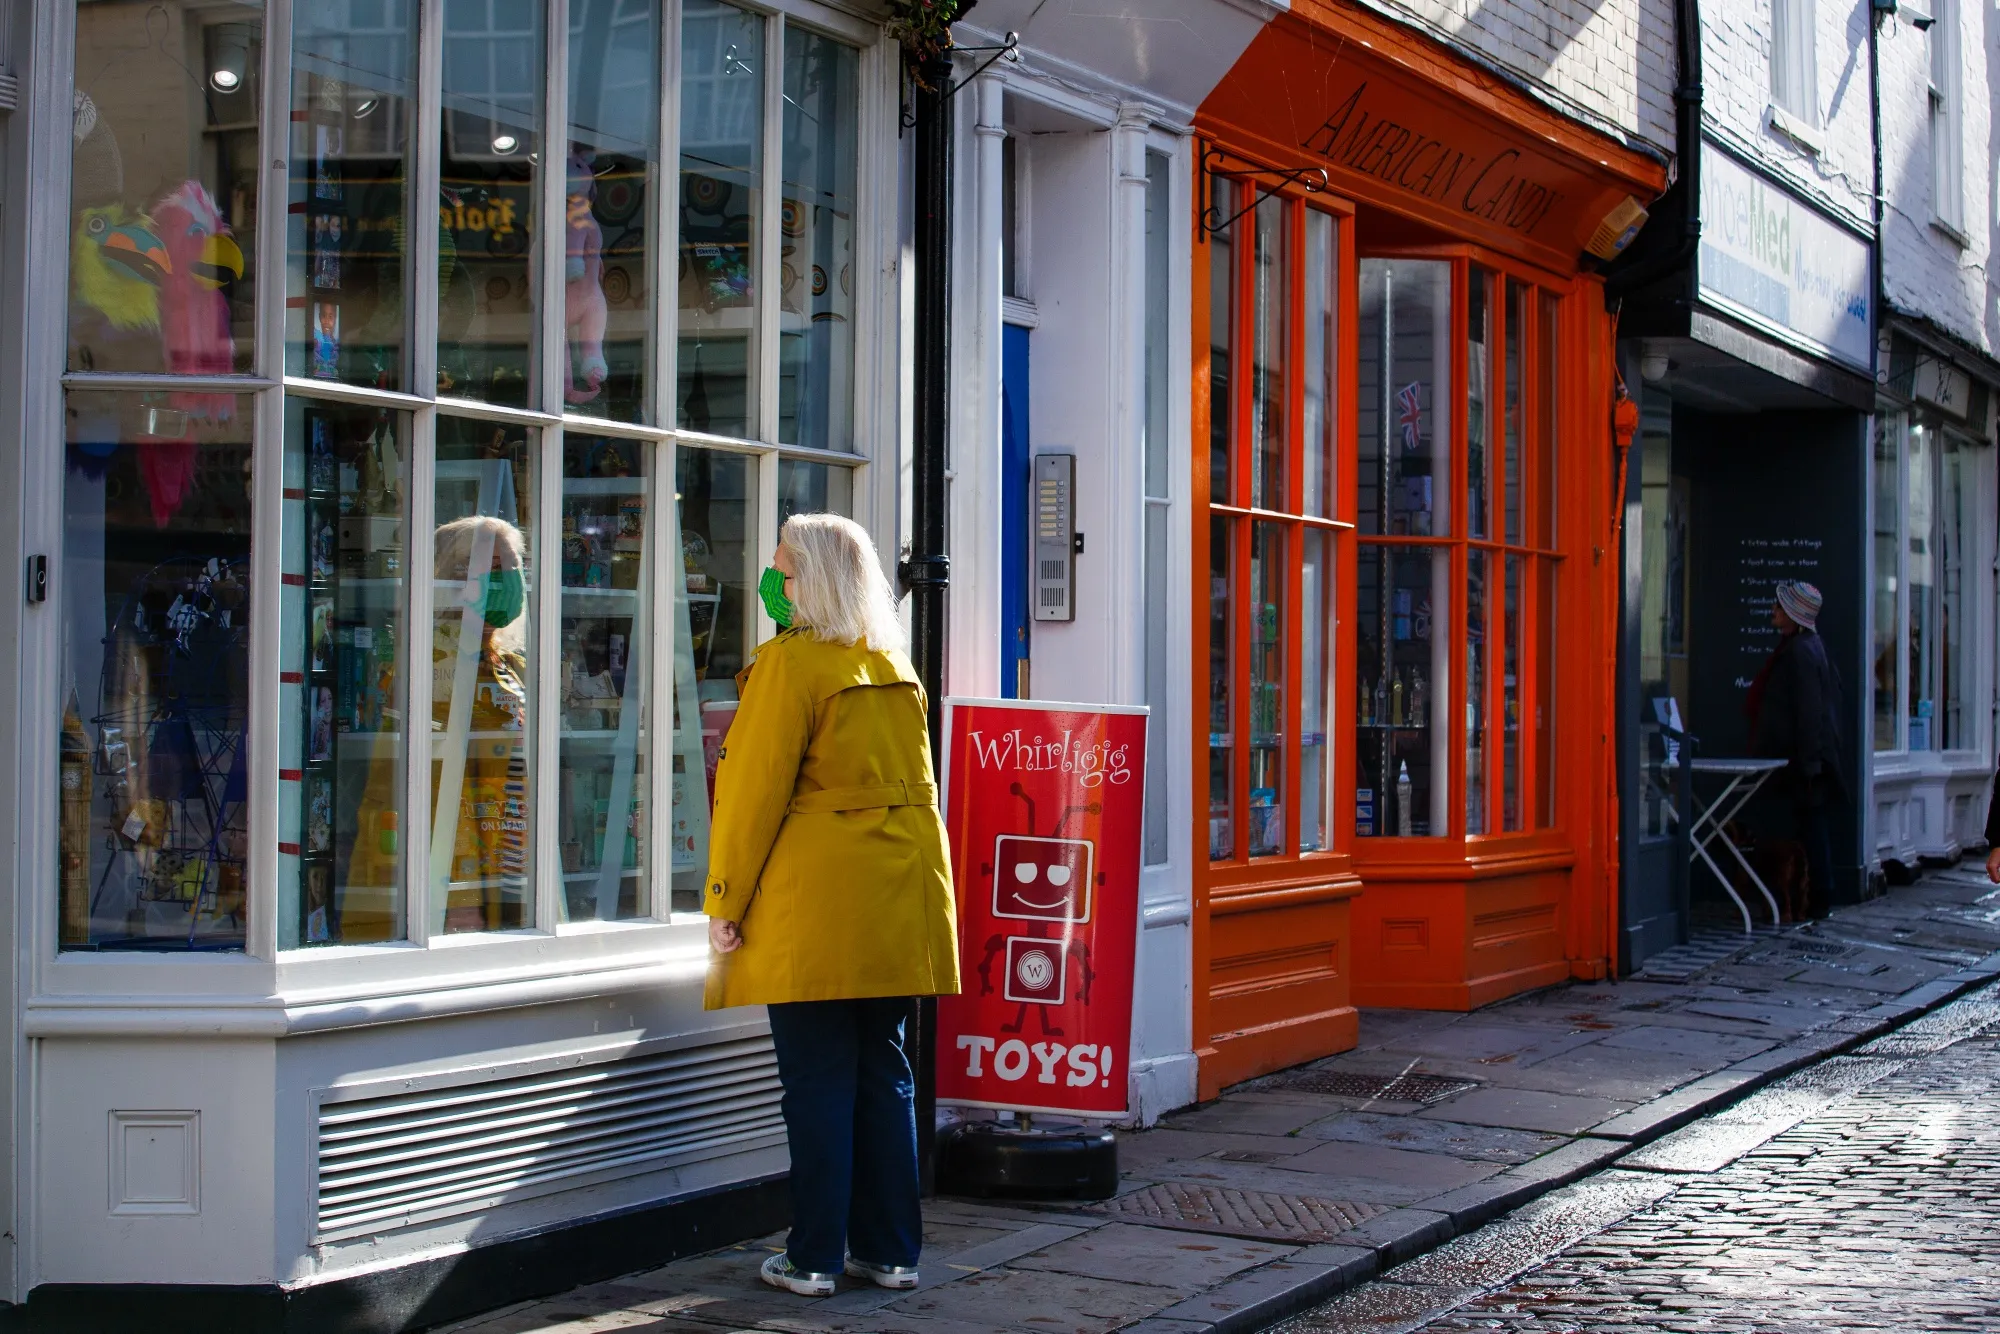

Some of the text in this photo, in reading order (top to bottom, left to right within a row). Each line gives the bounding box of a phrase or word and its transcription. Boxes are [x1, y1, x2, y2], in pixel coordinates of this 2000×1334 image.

[1300, 81, 1563, 235] AMERICAN CANDY
[968, 729, 1131, 788] Whirligig
[480, 820, 495, 831] ON
[1025, 964, 1043, 979] W
[956, 1035, 1113, 1089] TOYS!
